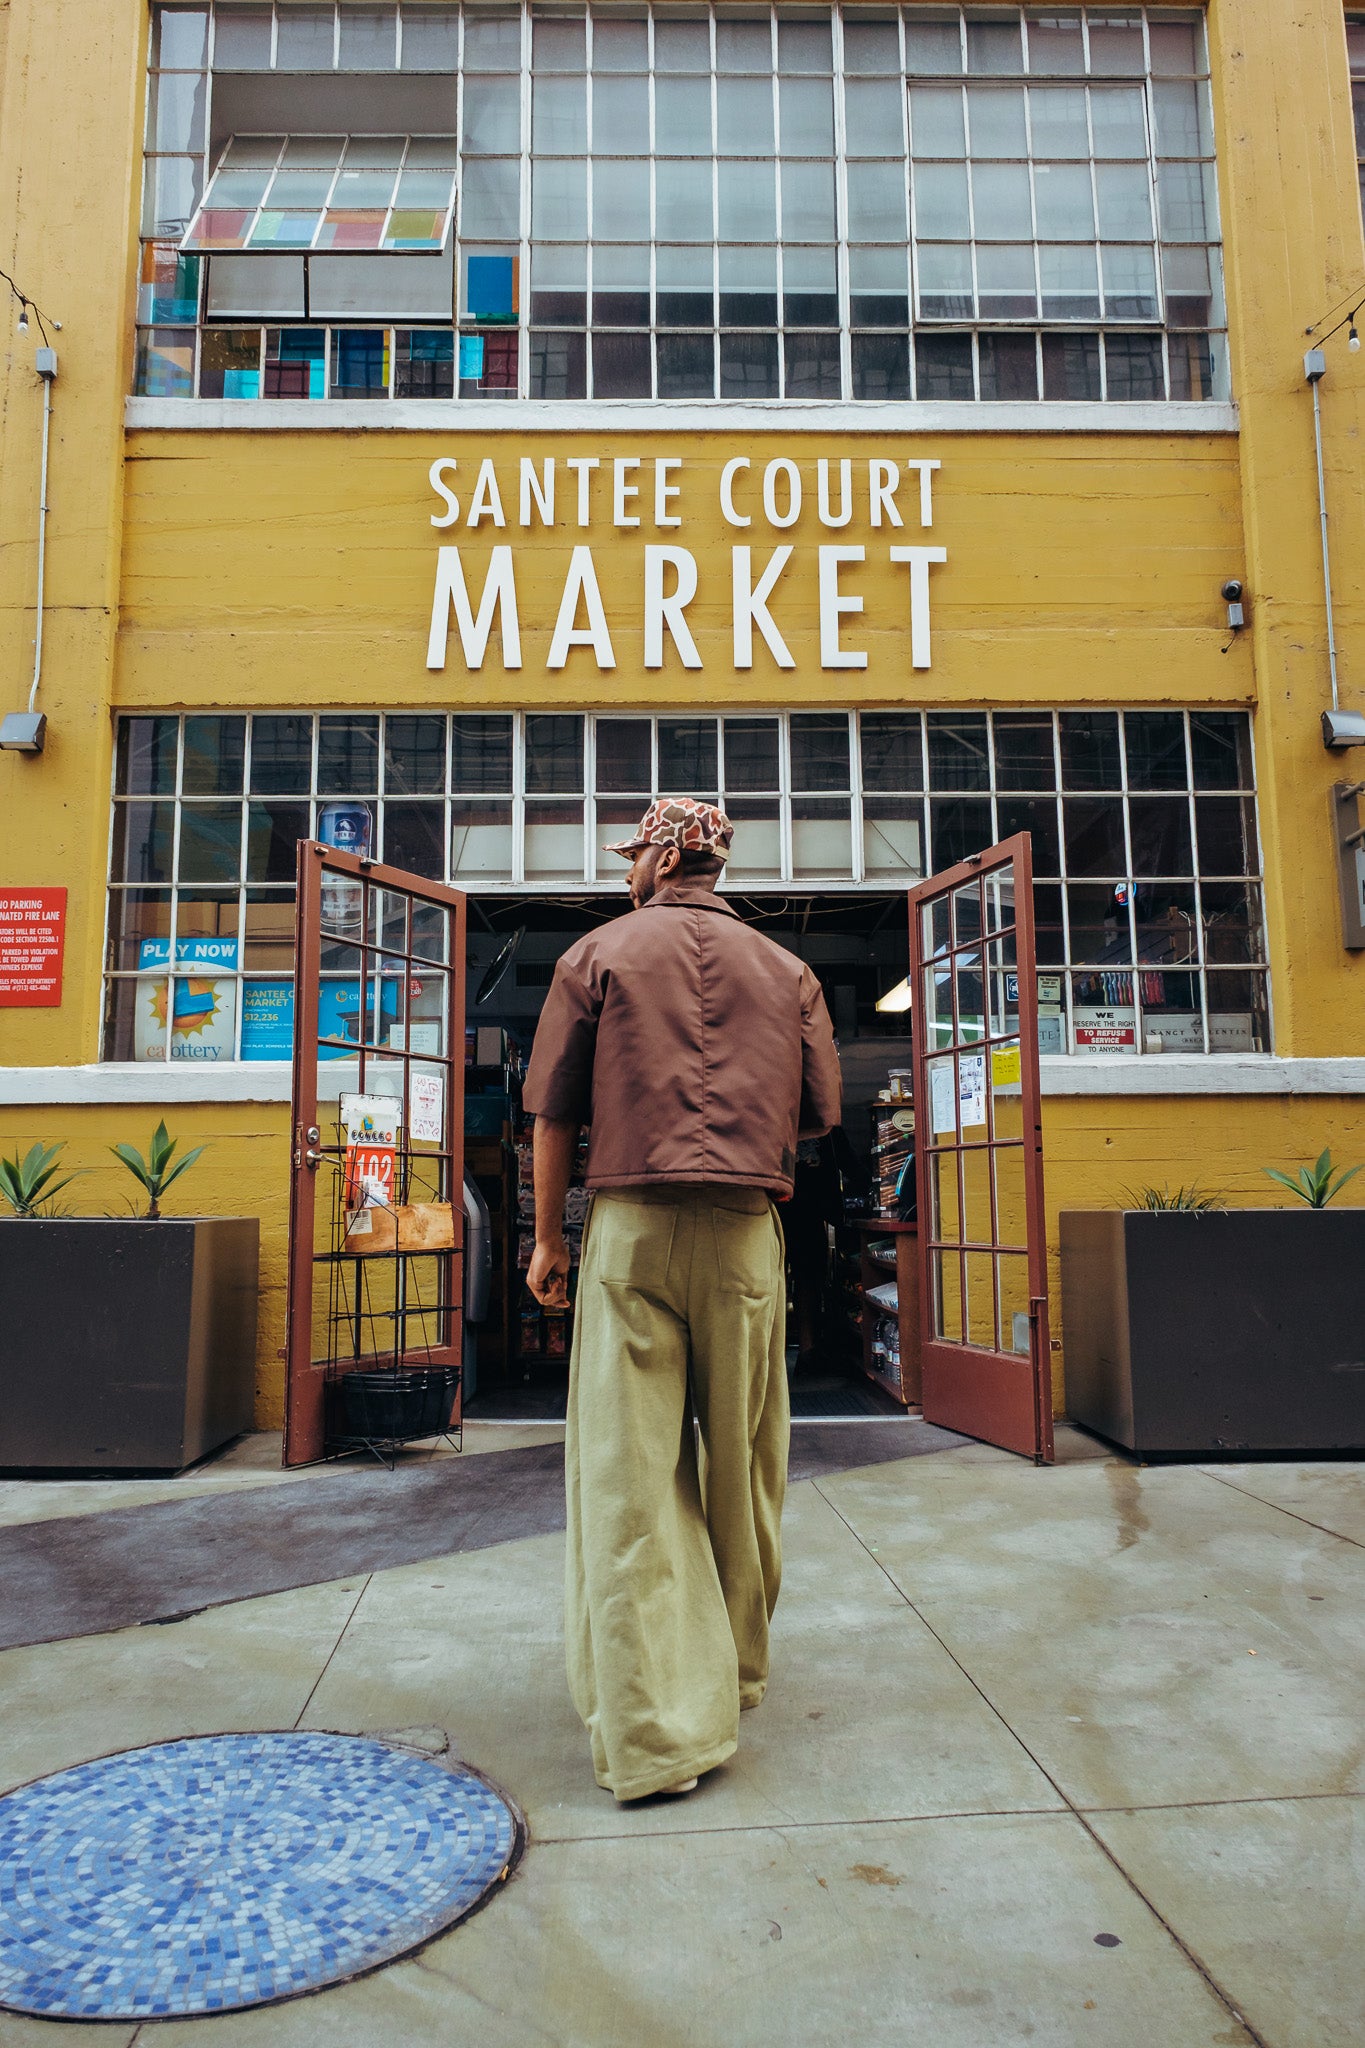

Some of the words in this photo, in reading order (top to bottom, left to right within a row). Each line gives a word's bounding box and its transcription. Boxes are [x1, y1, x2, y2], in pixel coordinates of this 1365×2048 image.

[428, 457, 683, 528] SANTEE
[720, 457, 942, 528] COURT
[426, 545, 947, 669] MARKET
[10, 900, 43, 909] PARKING
[25, 911, 40, 920] FIRE
[42, 911, 60, 920] LANE
[0, 935, 14, 943] CODE
[15, 935, 38, 943] SECTION
[194, 945, 236, 958] NOW
[245, 990, 286, 998] SANTEE
[245, 998, 289, 1007] MARKET
[244, 1012, 279, 1022] $12,236
[146, 1043, 221, 1061] caottery
